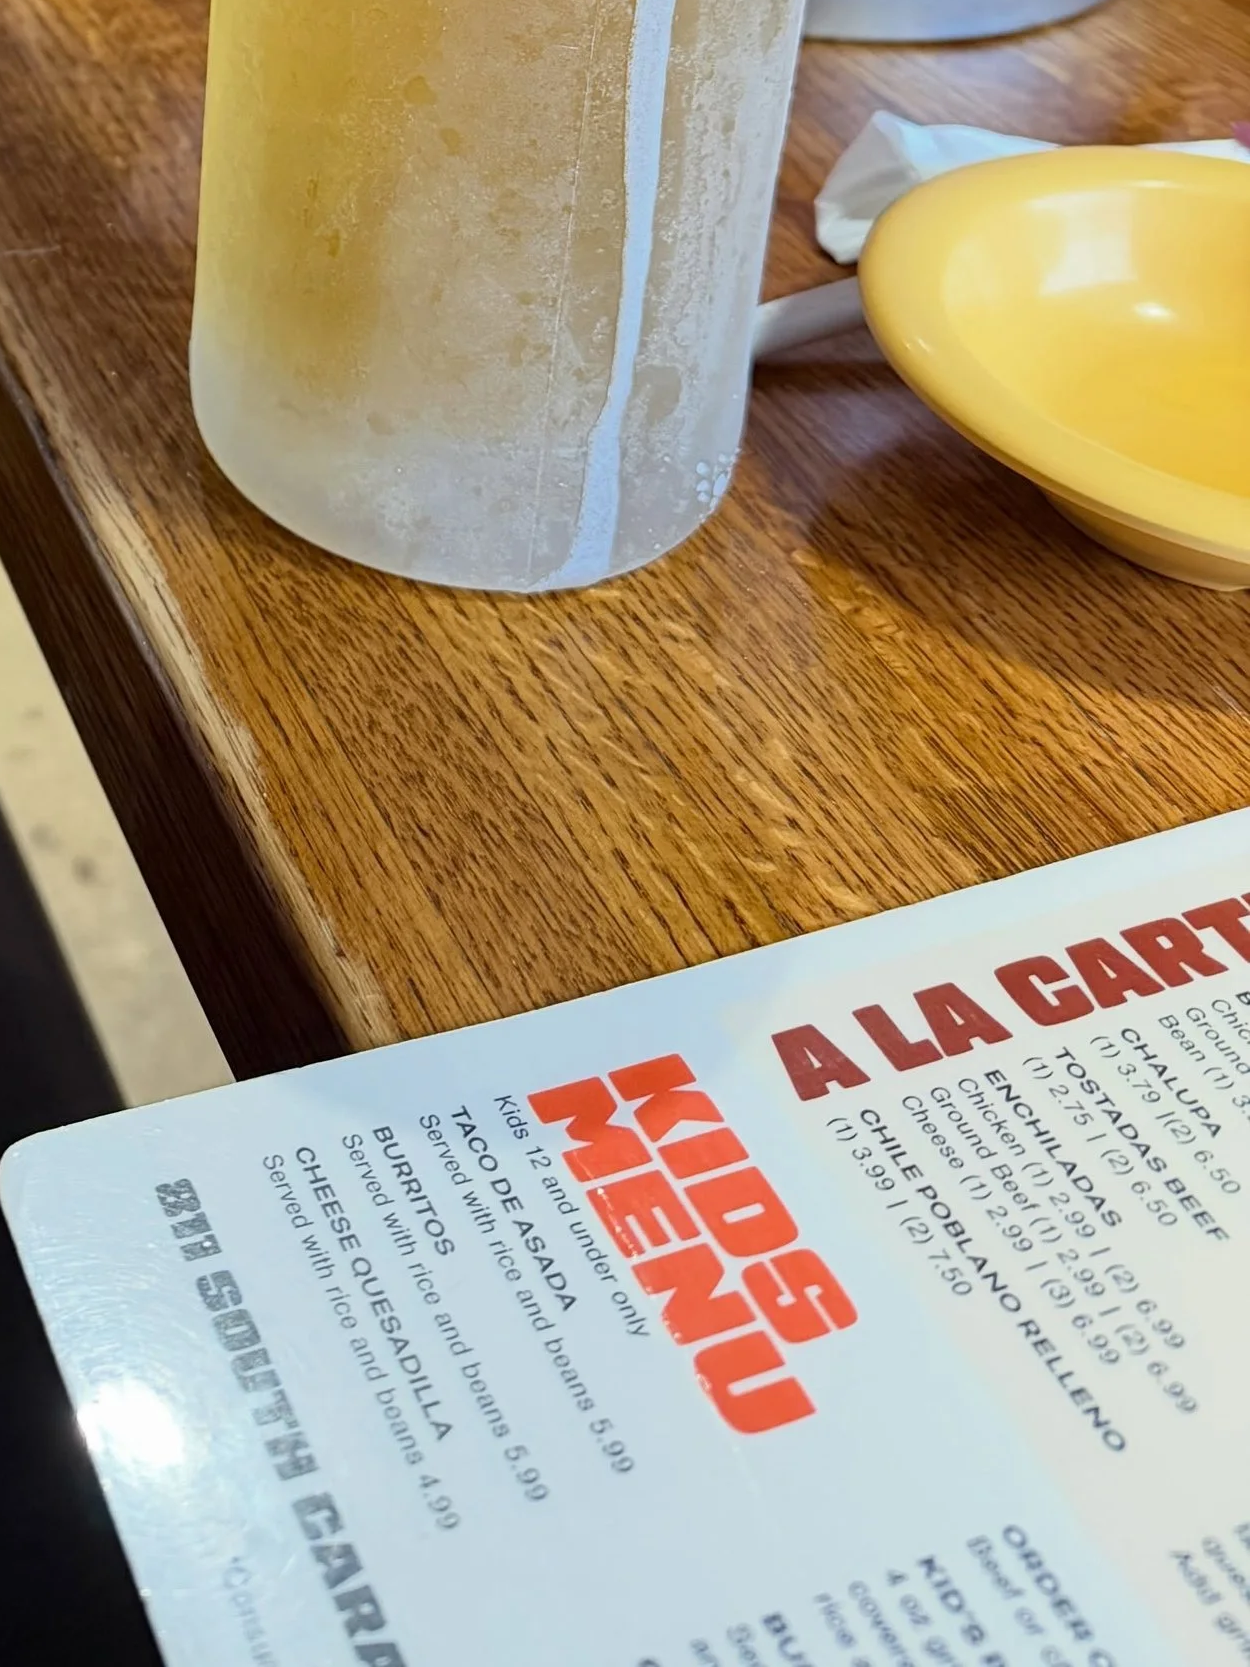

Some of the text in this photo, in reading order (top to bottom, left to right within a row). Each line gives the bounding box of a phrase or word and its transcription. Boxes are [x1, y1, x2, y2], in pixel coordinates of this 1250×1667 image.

[771, 892, 1250, 1101] A LA CART
[1120, 1028, 1222, 1138] CHALUPA
[1158, 1015, 1206, 1062] Bean
[1203, 1067, 1235, 1090] (1)
[1211, 999, 1250, 1044] Chic
[372, 1126, 455, 1256] BURRITOS
[451, 1105, 578, 1312] TACO DE ASADA
[493, 1095, 651, 1337] Kids 12 and under only
[608, 1053, 859, 1345] KIDS
[826, 1117, 858, 1142] (1)
[852, 1146, 896, 1191] 3.99
[899, 1216, 935, 1245] (2)
[928, 1249, 973, 1297] 7.50
[957, 1077, 1027, 1158] Chicken
[1021, 1161, 1054, 1187] (1)
[1049, 1192, 1096, 1238] 2.99
[1104, 1264, 1140, 1294] (2)
[1135, 1298, 1186, 1350] 6.99
[984, 1069, 1123, 1228] ENCHILADAS
[1022, 1057, 1054, 1080] (1)
[1048, 1084, 1094, 1126] 2.75
[1101, 1149, 1134, 1176] (2)
[1131, 1180, 1178, 1227] 6.50
[1055, 1046, 1231, 1241] TOSTADAS BEEF
[1090, 1036, 1121, 1058] (1)
[1117, 1063, 1161, 1103] 3.79
[1194, 1150, 1241, 1194] 6.50
[296, 1146, 453, 1441] CHEESE QUESADILLA
[342, 1134, 550, 1502] Served with rice and beans 5.99
[419, 1114, 635, 1473] Served with rice and beans 5.99
[527, 1076, 817, 1435] MENU
[860, 1108, 1126, 1452] CHILE POBLANO RELLENO
[902, 1095, 964, 1170] Cheese
[959, 1174, 993, 1201] (1)
[985, 1205, 1034, 1253] 2.99
[1040, 1278, 1076, 1309] (3)
[1071, 1314, 1121, 1365] 6.99
[930, 1086, 997, 1161] Ground
[990, 1163, 1041, 1211] Beef
[1029, 1217, 1062, 1244] (1)
[1056, 1248, 1106, 1298] 2.99
[1114, 1323, 1150, 1356] (2)
[1146, 1360, 1199, 1414] 6.99
[195, 1270, 320, 1481] SOUTH
[263, 1154, 460, 1530] Served with rice and beans 4.99
[1002, 1524, 1094, 1641] ORDER
